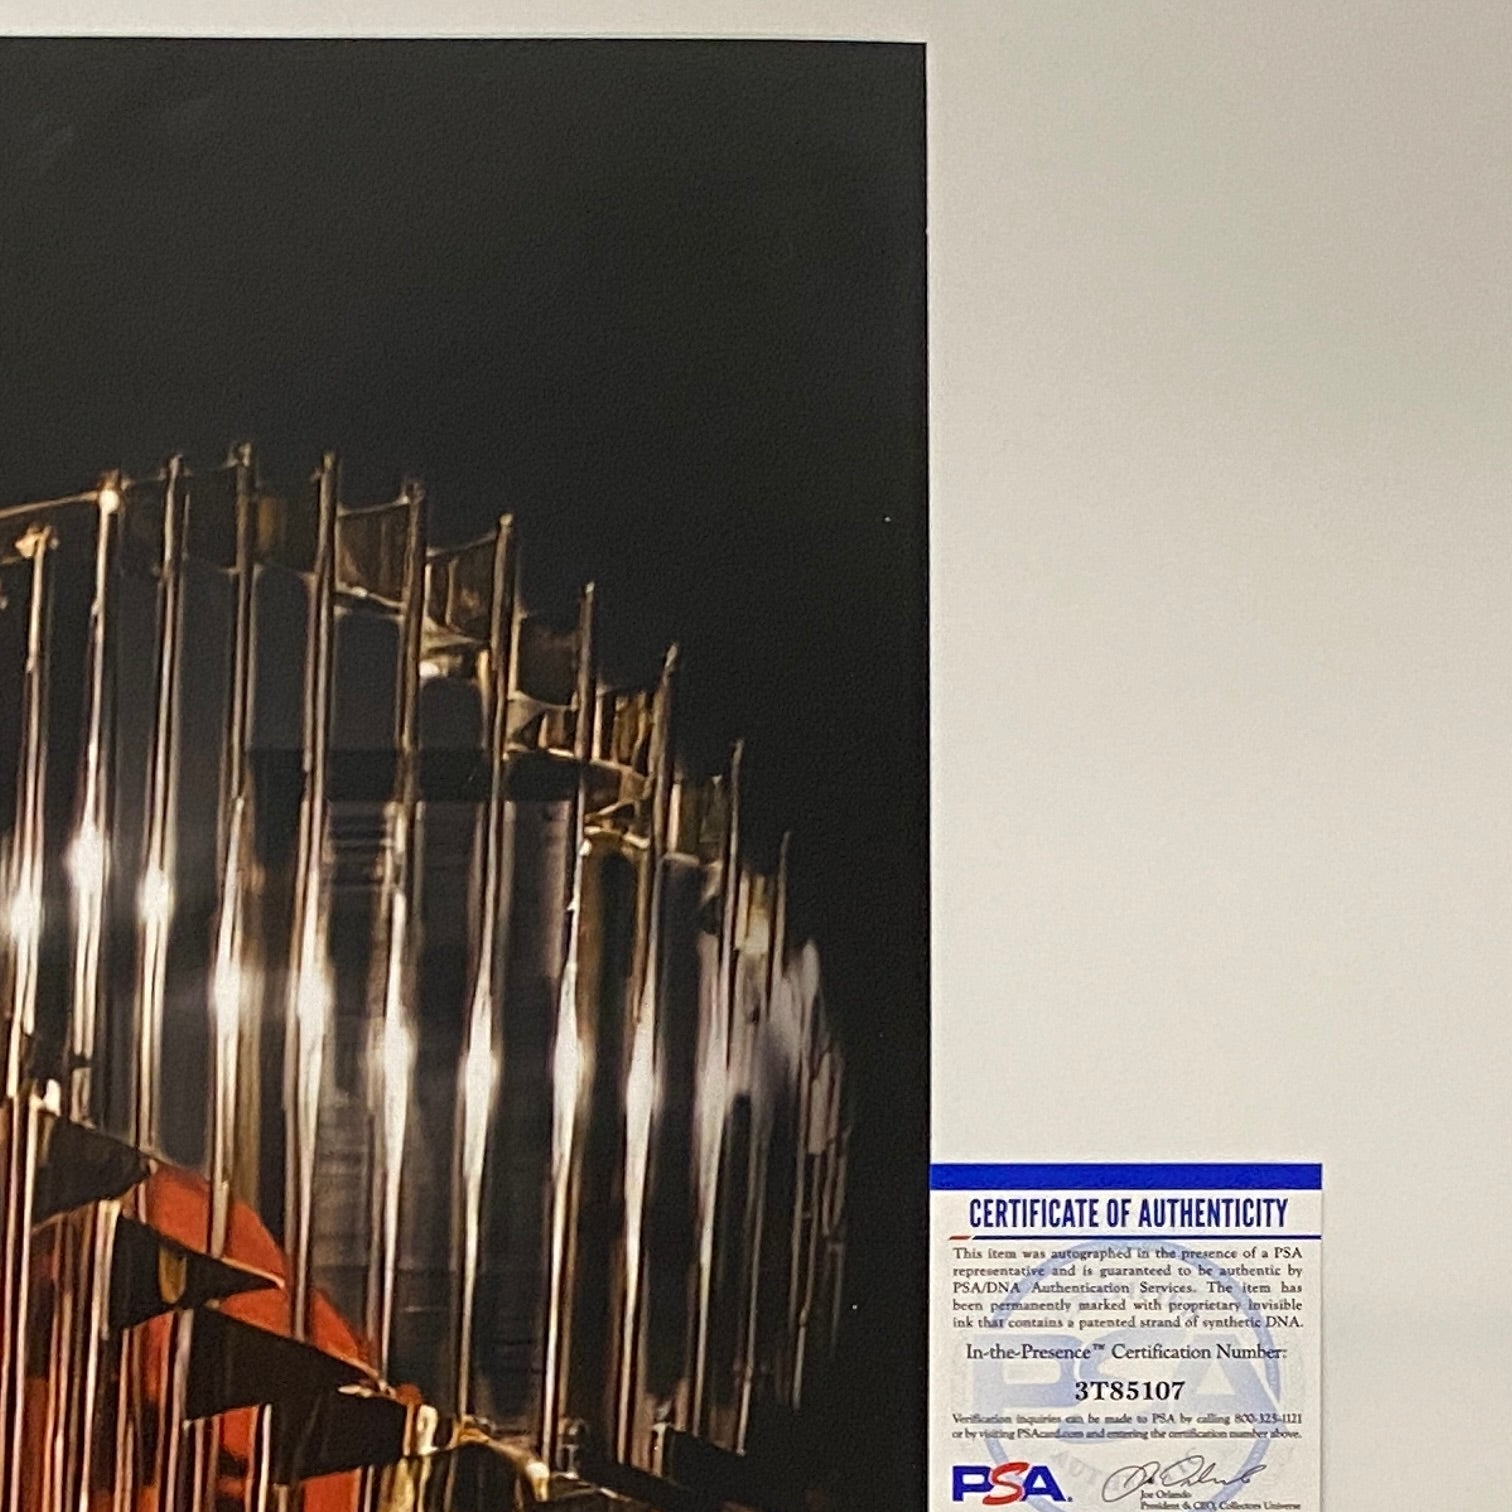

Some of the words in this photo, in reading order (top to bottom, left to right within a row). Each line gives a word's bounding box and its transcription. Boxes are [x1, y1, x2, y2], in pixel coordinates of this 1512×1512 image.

[969, 1199, 1099, 1228] CERTIFICATE
[1107, 1199, 1131, 1228] OF
[1138, 1199, 1289, 1228] AUTHENTICITY
[953, 1248, 982, 1260] This
[988, 1248, 1016, 1260] item
[1022, 1251, 1046, 1260] was
[1051, 1248, 1132, 1263] autographed
[1137, 1248, 1149, 1260] in
[1156, 1248, 1176, 1260] the
[1181, 1251, 1238, 1263] presence
[1243, 1248, 1256, 1260] of
[1261, 1251, 1269, 1260] a
[1274, 1248, 1303, 1260] PSA
[953, 1265, 1045, 1280] representative
[1052, 1265, 1075, 1277] and
[1083, 1265, 1093, 1277] is
[1099, 1265, 1171, 1280] guaranteed
[1178, 1265, 1191, 1277] to
[1198, 1265, 1213, 1277] be
[1219, 1265, 1281, 1277] authentic
[1287, 1265, 1303, 1280] by
[953, 1282, 1020, 1294] PSA/DNA
[1032, 1282, 1130, 1294] Authentication
[1139, 1282, 1197, 1294] Services.
[1207, 1282, 1233, 1294] The
[1242, 1282, 1271, 1294] item
[1280, 1282, 1302, 1294] has
[953, 1299, 983, 1311] been
[990, 1299, 1071, 1314] permanently
[1079, 1299, 1125, 1311] marked
[1133, 1299, 1161, 1311] with
[1168, 1299, 1241, 1314] proprietary
[1248, 1299, 1302, 1311] invisible
[953, 1316, 973, 1328] ink
[978, 1316, 1004, 1328] that
[1008, 1316, 1063, 1328] contains
[1068, 1319, 1074, 1328] a
[1079, 1316, 1136, 1331] patented
[1140, 1316, 1180, 1328] strand
[1185, 1316, 1198, 1328] of
[1202, 1316, 1261, 1331] synthetic
[1266, 1316, 1303, 1328] DNA.
[1111, 1344, 1211, 1360] Certification
[1216, 1344, 1287, 1360] Number:
[1075, 1381, 1185, 1401] 3T85107
[952, 1462, 1064, 1506] PSA
[1141, 1490, 1153, 1499] Joe
[1155, 1490, 1192, 1498] Orlando
